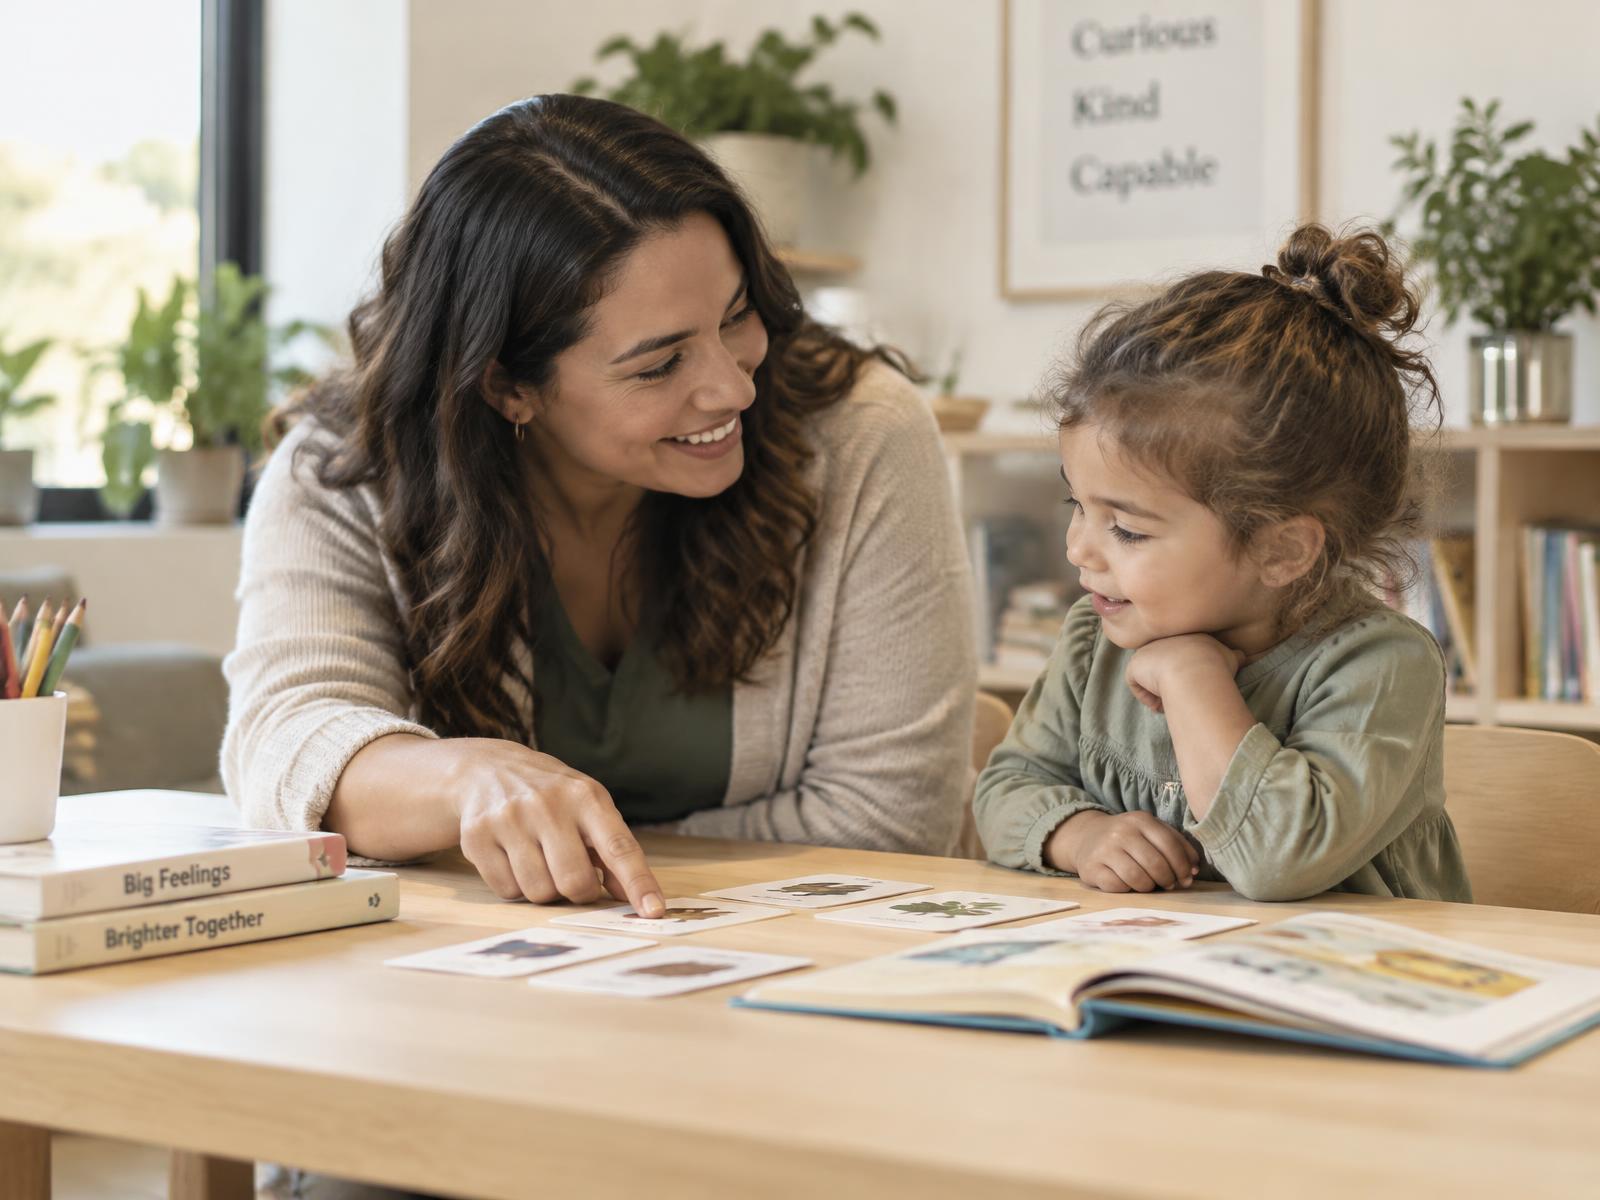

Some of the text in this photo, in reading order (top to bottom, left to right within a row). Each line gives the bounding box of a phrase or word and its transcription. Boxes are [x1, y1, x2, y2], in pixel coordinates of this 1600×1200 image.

[1071, 15, 1218, 59] Curious
[1072, 80, 1161, 126] Kind
[1070, 147, 1218, 201] Capable
[123, 864, 231, 897] Big Feelings
[105, 910, 264, 950] Brighter Together
